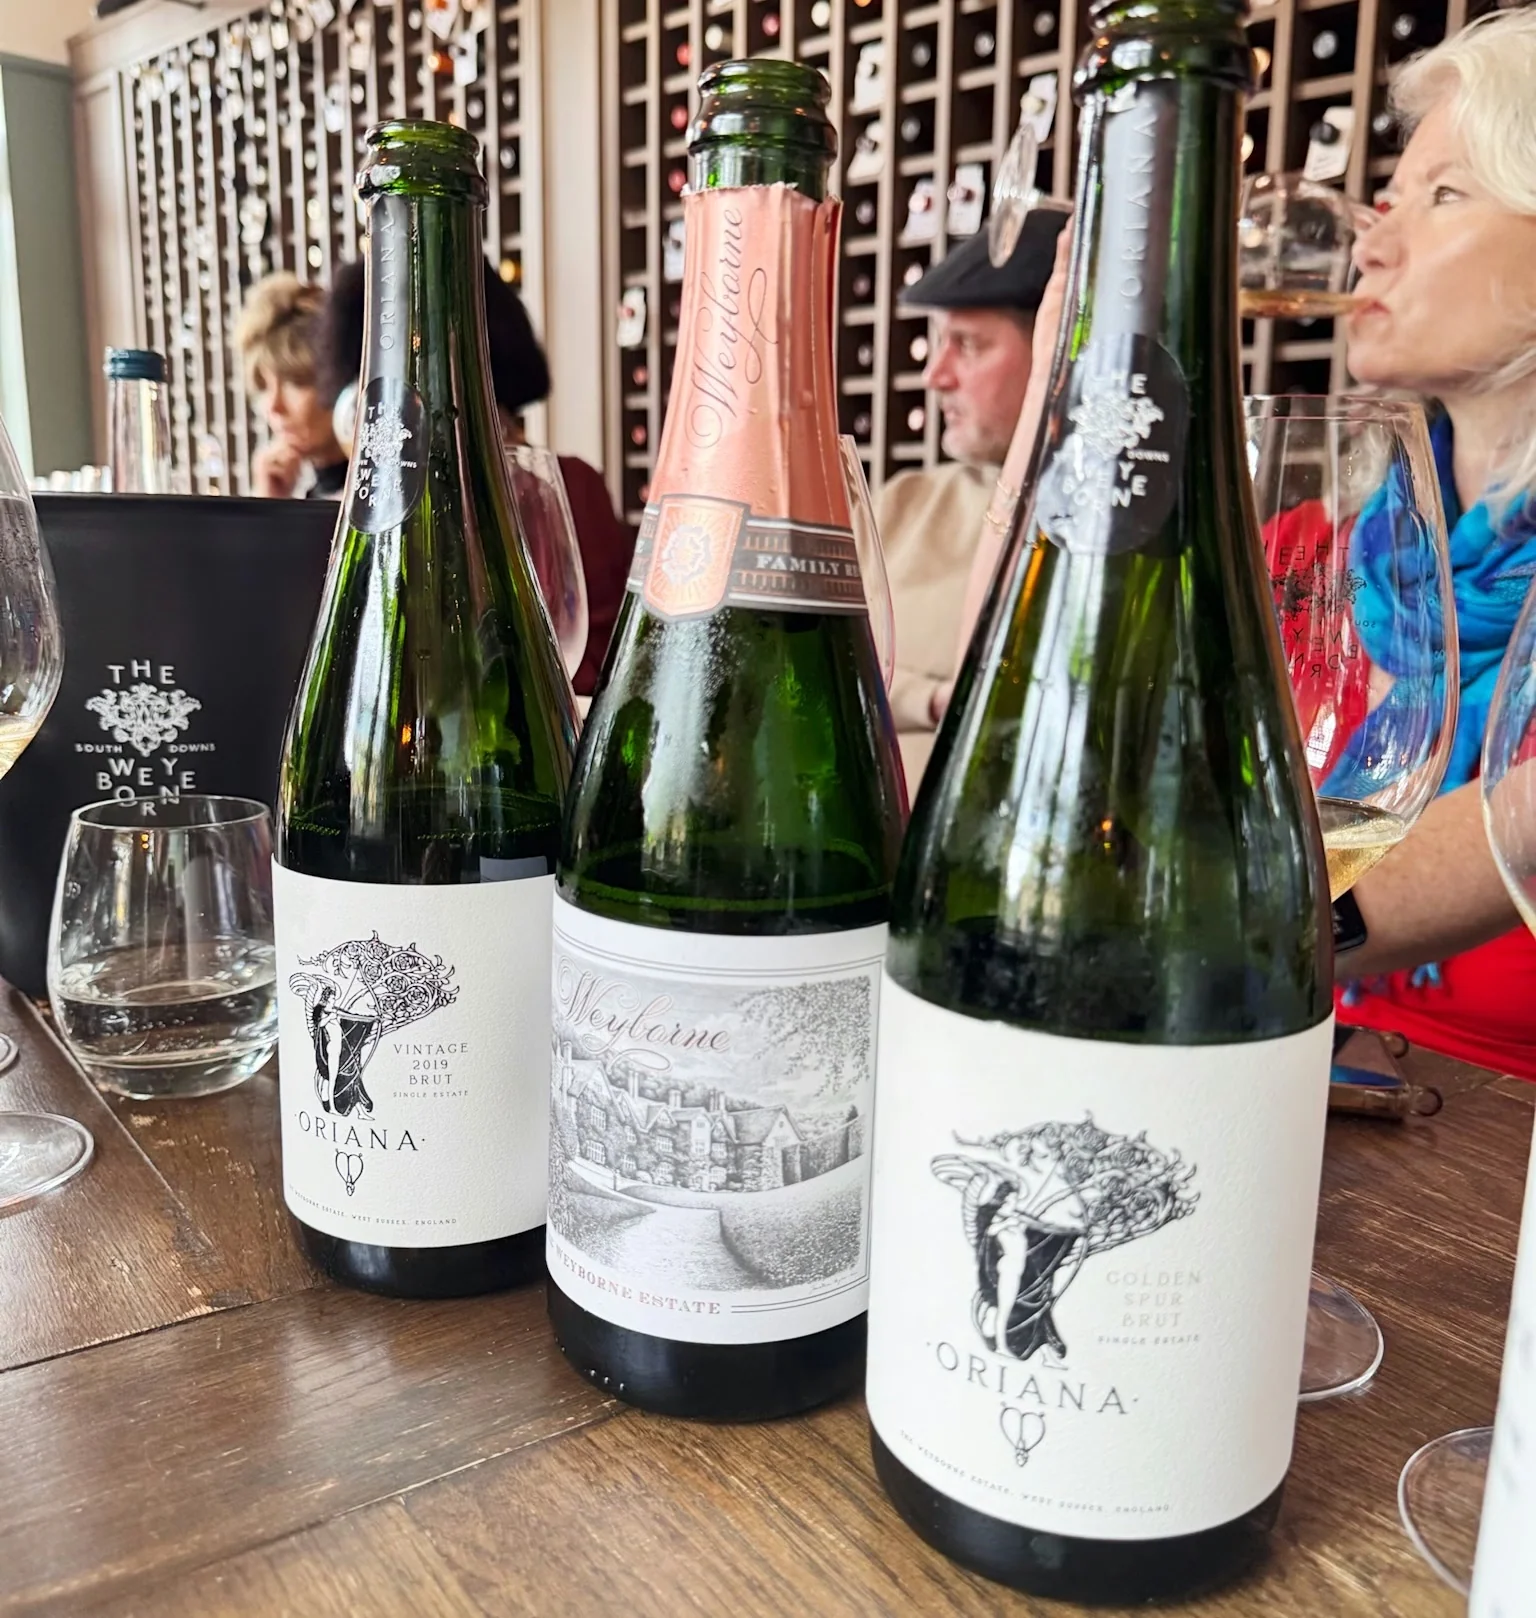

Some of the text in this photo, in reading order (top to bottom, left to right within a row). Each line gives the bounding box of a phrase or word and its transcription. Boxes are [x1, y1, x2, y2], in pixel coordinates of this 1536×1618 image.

[685, 207, 778, 449] Weyborne
[756, 554, 839, 576] FAMILY
[107, 659, 176, 684] THE
[75, 743, 216, 753] SOUTH DOWNS
[557, 954, 732, 1072] Weyborne
[393, 1042, 469, 1055] VINTAGE
[412, 1059, 449, 1070] 2019
[409, 1073, 453, 1085] BRUT
[433, 1090, 469, 1098] ESTATE
[415, 1218, 457, 1226] ENGLAND
[556, 1245, 721, 1315] WEYBORNE ESTATE
[1106, 1270, 1200, 1288] GOLDEN
[1123, 1291, 1183, 1307] SPUR
[1121, 1312, 1181, 1328] BRUT
